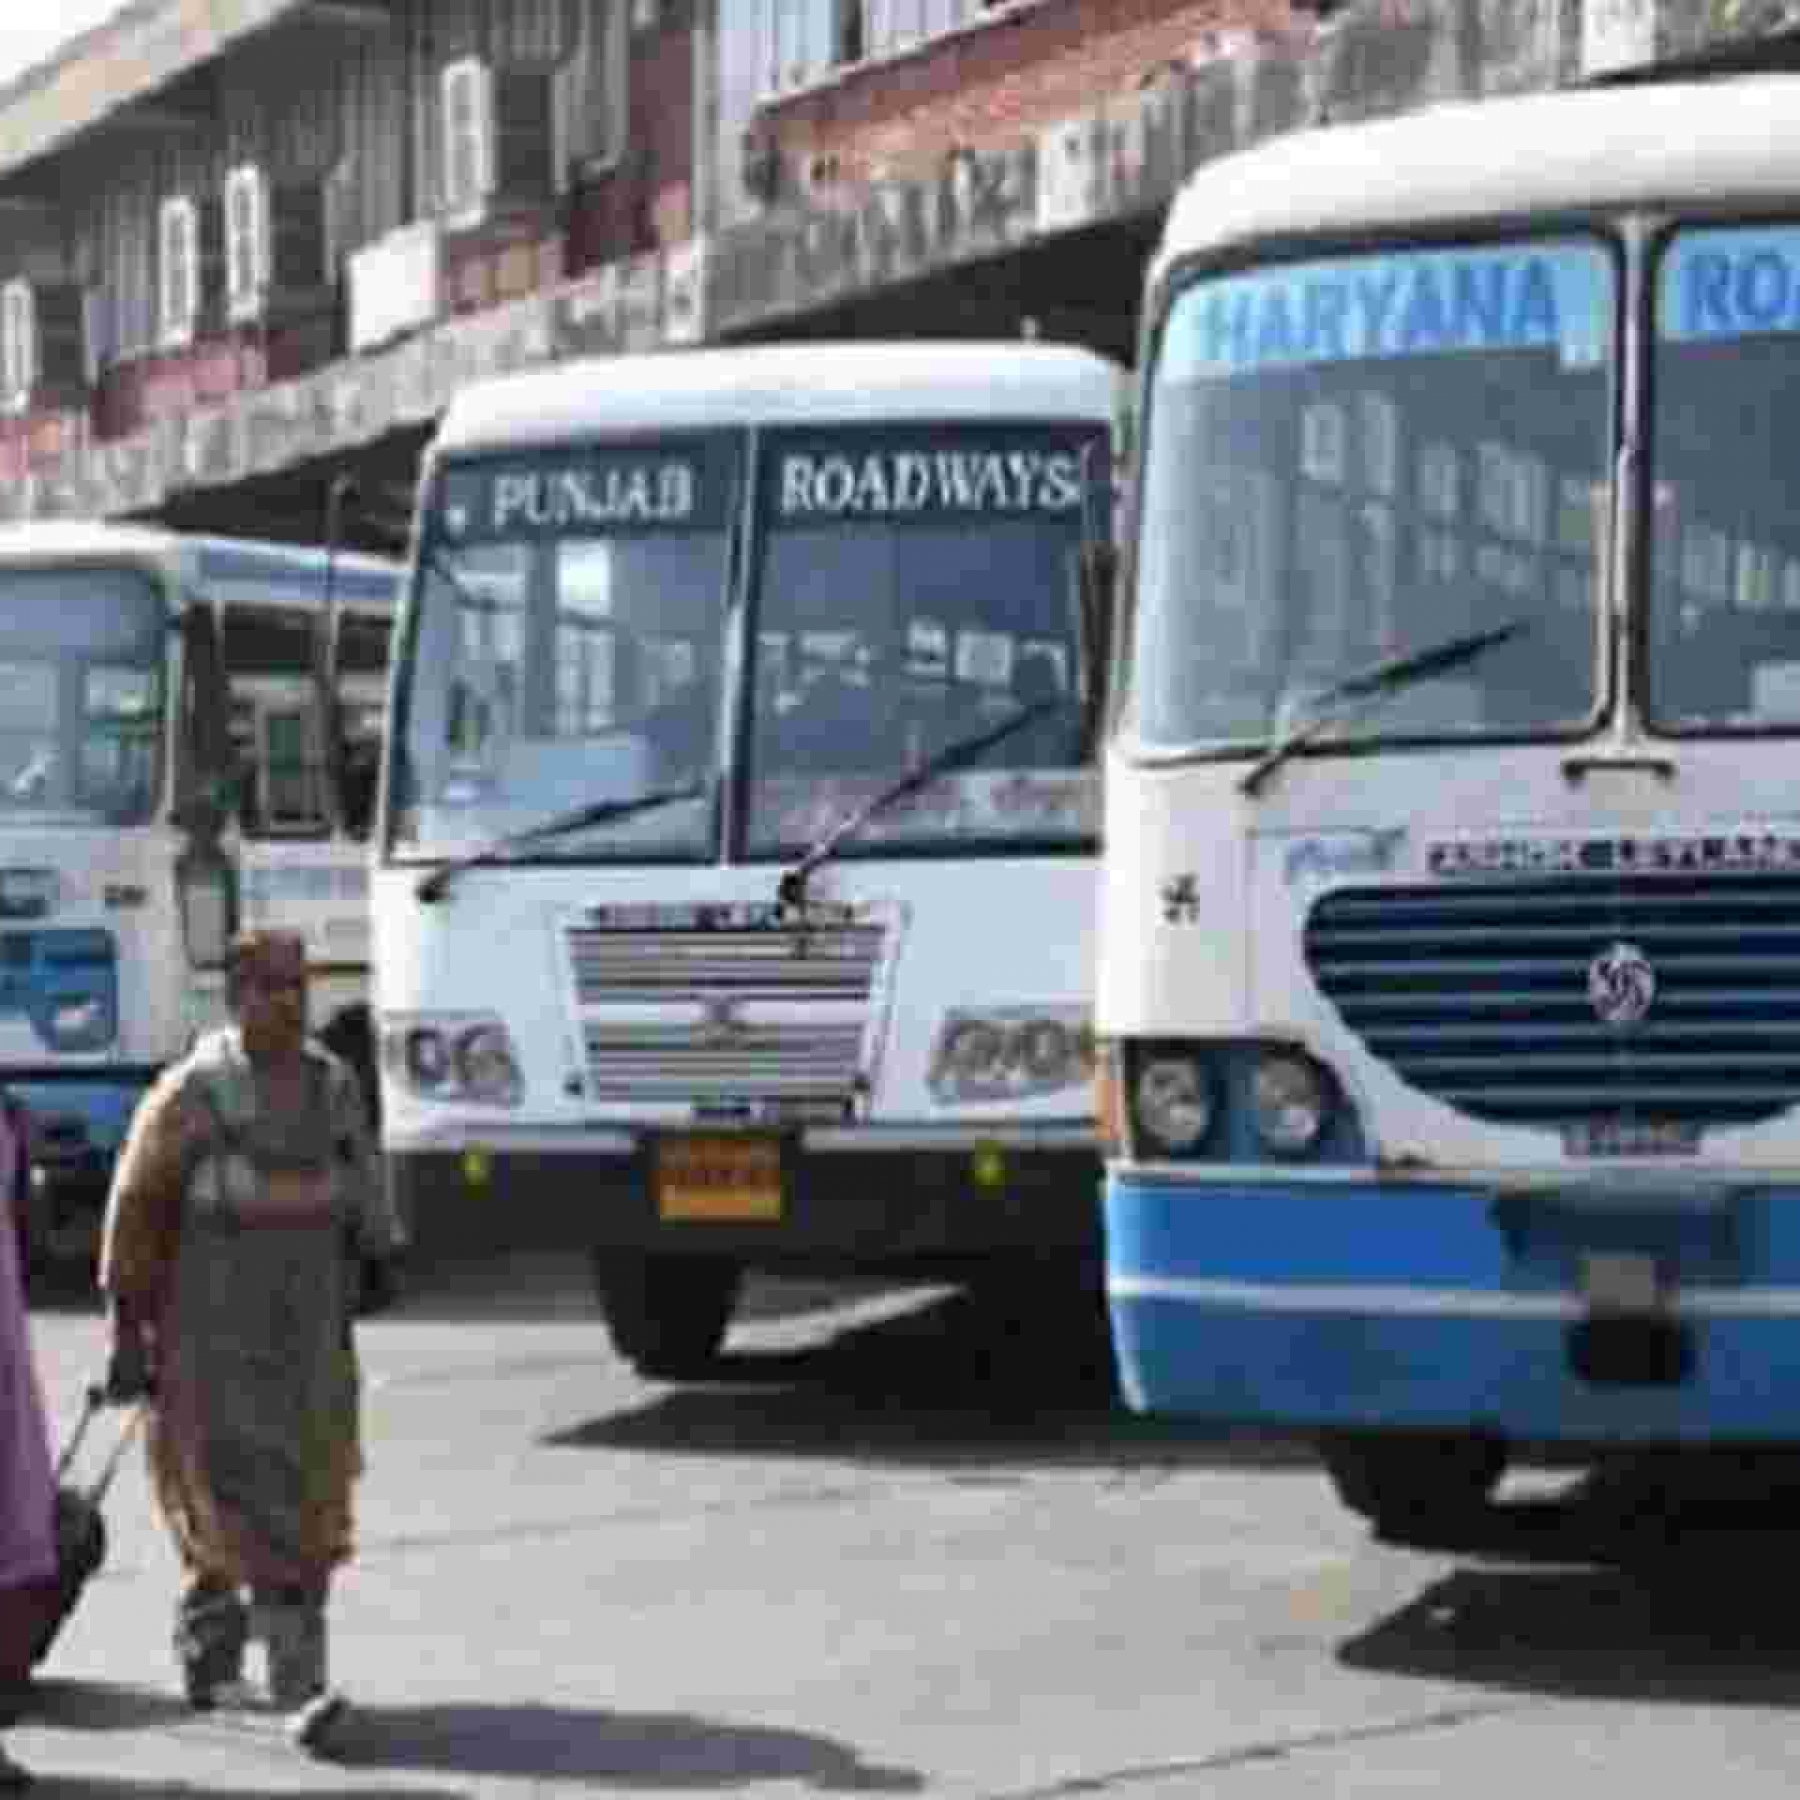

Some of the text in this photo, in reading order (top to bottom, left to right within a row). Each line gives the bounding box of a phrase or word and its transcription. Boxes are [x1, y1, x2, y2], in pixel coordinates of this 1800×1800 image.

[1203, 249, 1800, 368] HARYANA RO
[494, 450, 1081, 527] PUNJAB ROADWAYS
